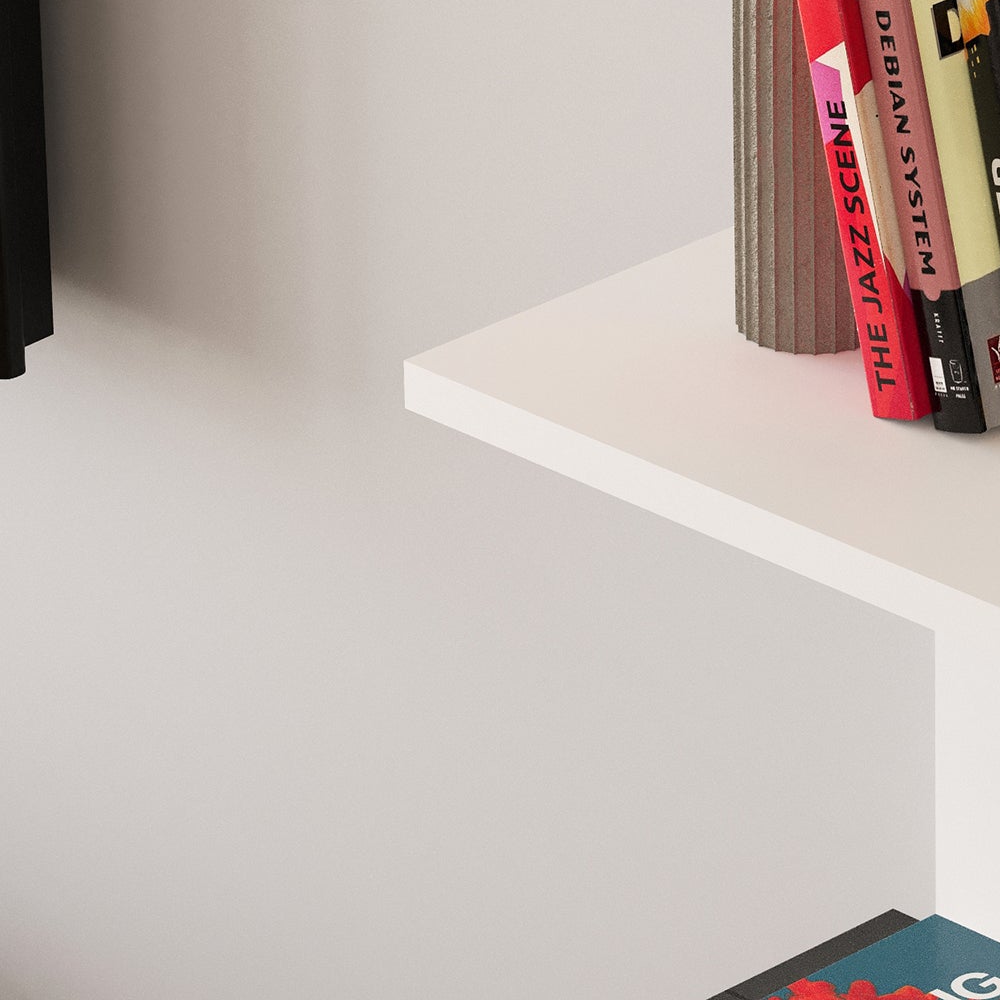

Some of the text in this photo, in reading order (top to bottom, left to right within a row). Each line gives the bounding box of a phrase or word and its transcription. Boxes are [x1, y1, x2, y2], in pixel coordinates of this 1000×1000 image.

[826, 99, 897, 392] THE JAZZ SCENE
[875, 10, 937, 276] DEBIAN SYSTEM
